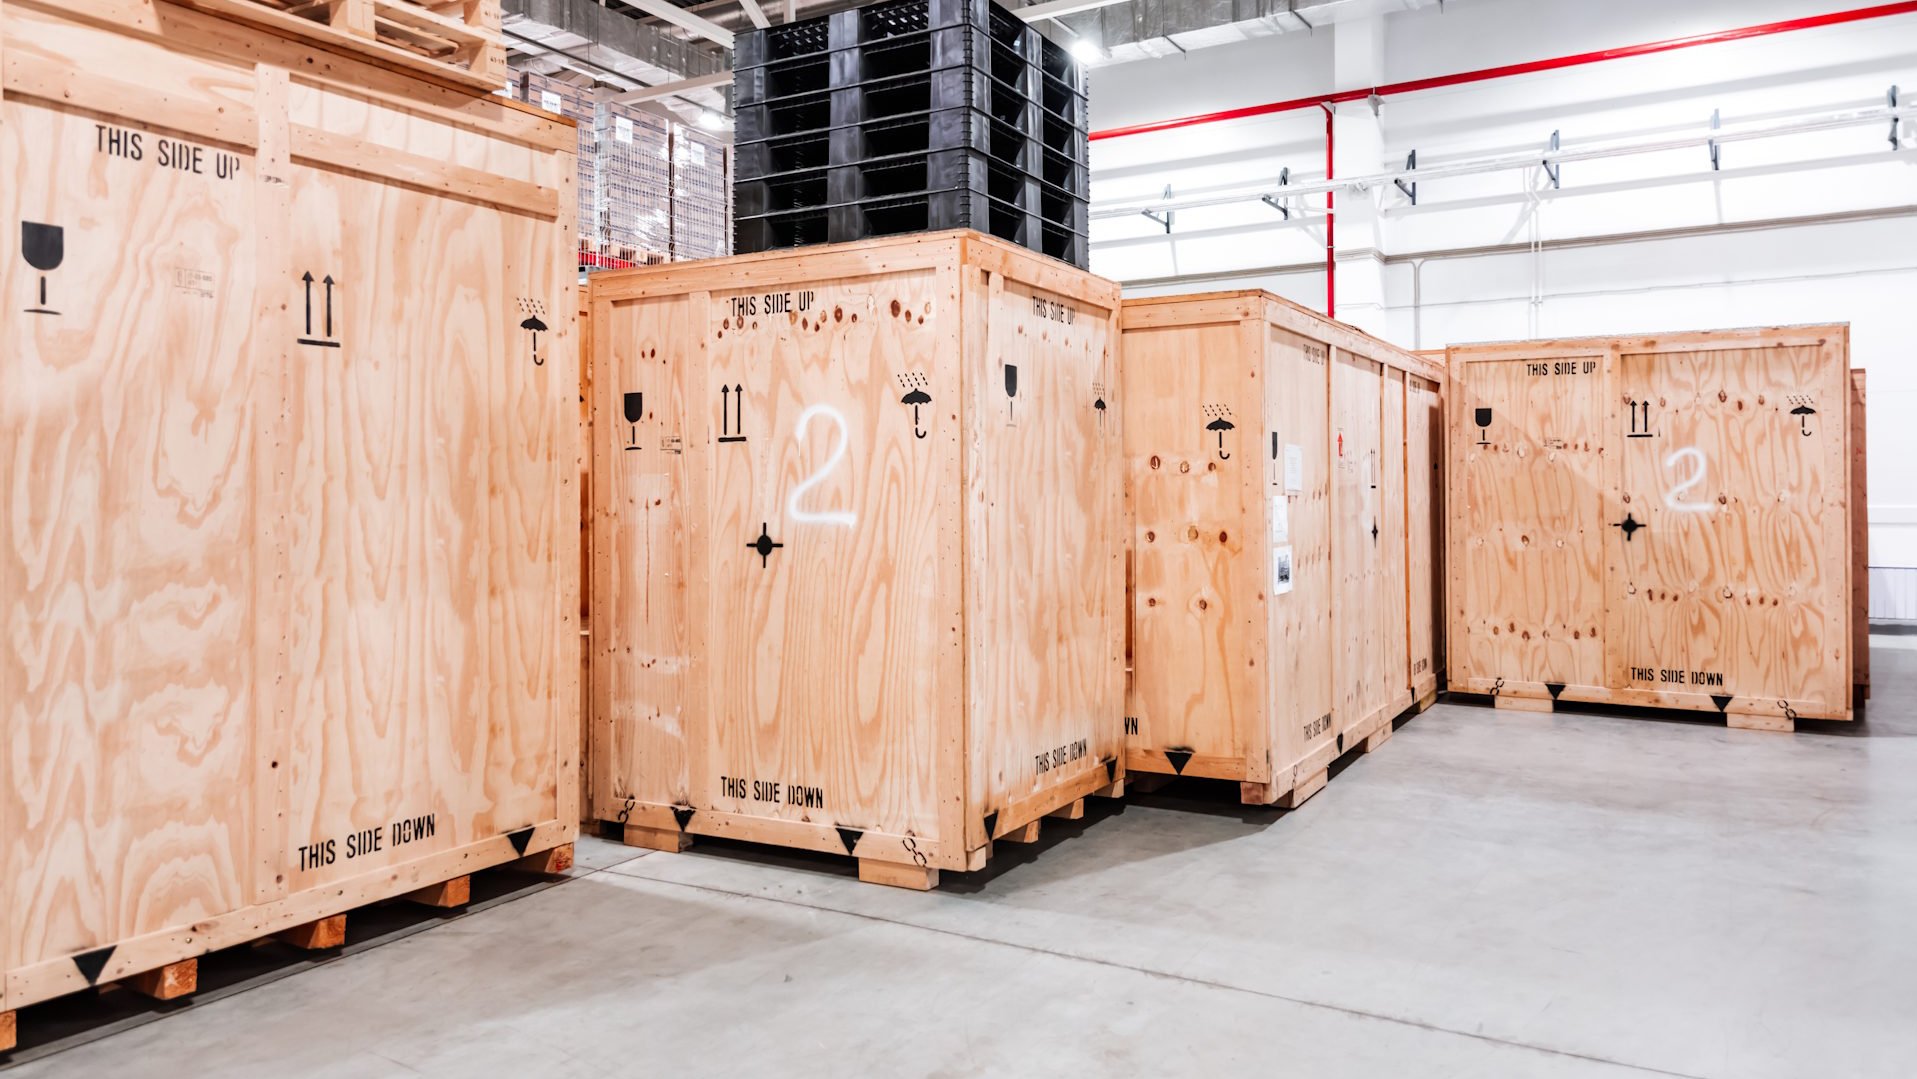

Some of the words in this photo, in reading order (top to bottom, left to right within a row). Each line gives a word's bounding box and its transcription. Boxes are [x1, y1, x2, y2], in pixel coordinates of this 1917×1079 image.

[95, 124, 143, 161] THIS
[157, 139, 203, 175] SIDE
[216, 152, 240, 180] UP
[731, 296, 756, 317] THIS
[764, 292, 791, 315] SIDE
[799, 291, 814, 312] UP
[1032, 295, 1047, 318] THIS
[1050, 301, 1064, 323] SIDE
[1067, 305, 1076, 325] UP
[1527, 363, 1548, 376] THIS
[1554, 362, 1577, 375] SIDE
[1583, 361, 1596, 374] UP
[789, 403, 857, 529] 2
[1665, 446, 1716, 513] 2
[1630, 667, 1654, 681] THIS
[1660, 669, 1685, 684] SIDE
[1691, 671, 1723, 686] DOWN
[1124, 716, 1138, 735] WN
[1035, 752, 1050, 776] THIS
[1052, 745, 1067, 769] SIDE
[1069, 738, 1087, 762] DOWN
[721, 776, 746, 799] THIS
[754, 780, 780, 803] SIDE
[788, 785, 823, 809] DOWN
[298, 839, 336, 872] THIS
[346, 826, 383, 859] SIDE
[392, 813, 435, 847] DOWN
